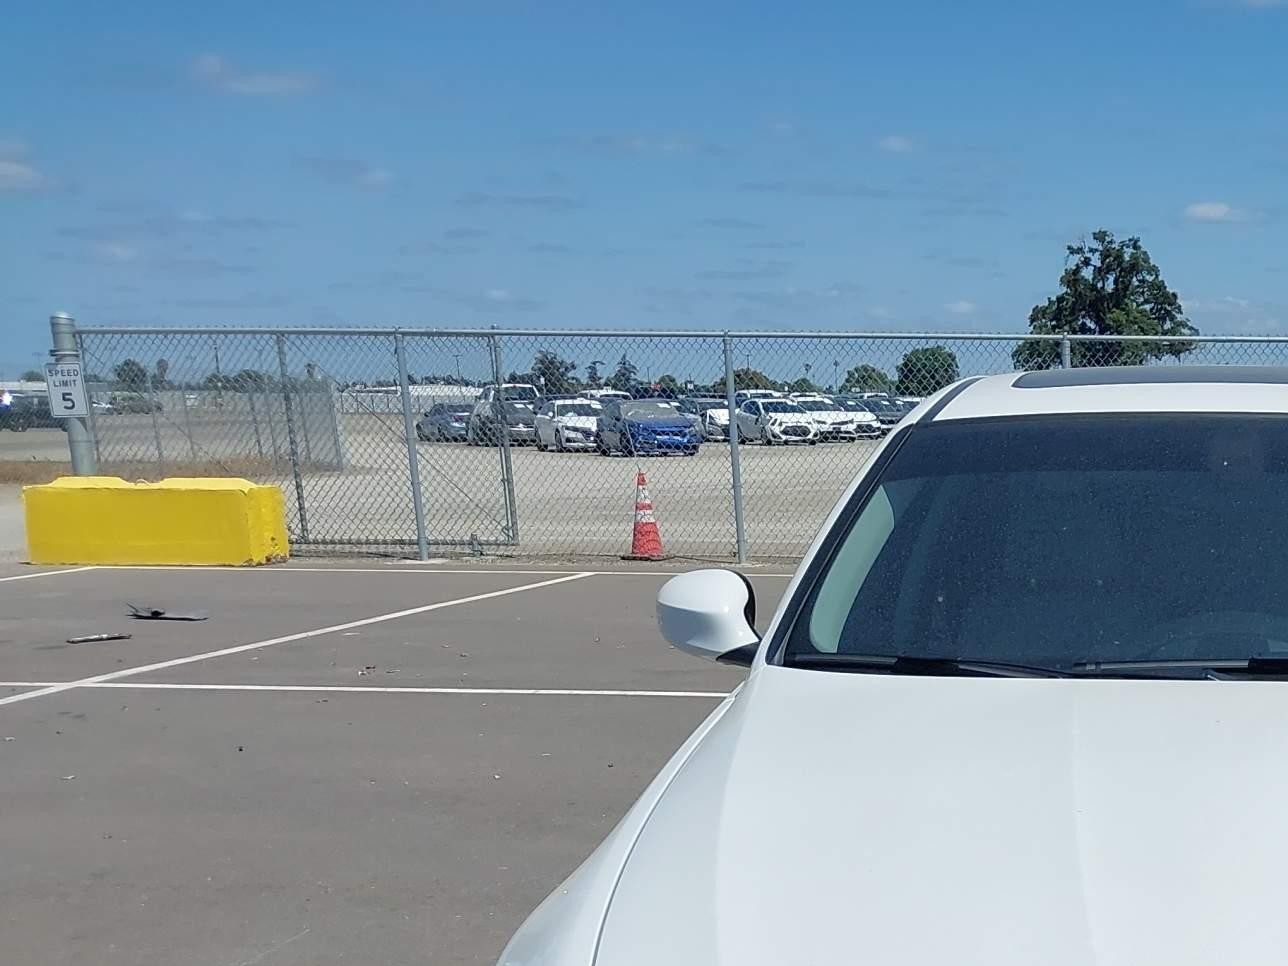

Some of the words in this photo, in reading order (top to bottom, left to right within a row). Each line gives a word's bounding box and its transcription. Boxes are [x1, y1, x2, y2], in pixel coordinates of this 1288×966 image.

[47, 368, 79, 377] SPEED
[53, 379, 77, 387] LIMIT
[61, 392, 76, 410] 5
